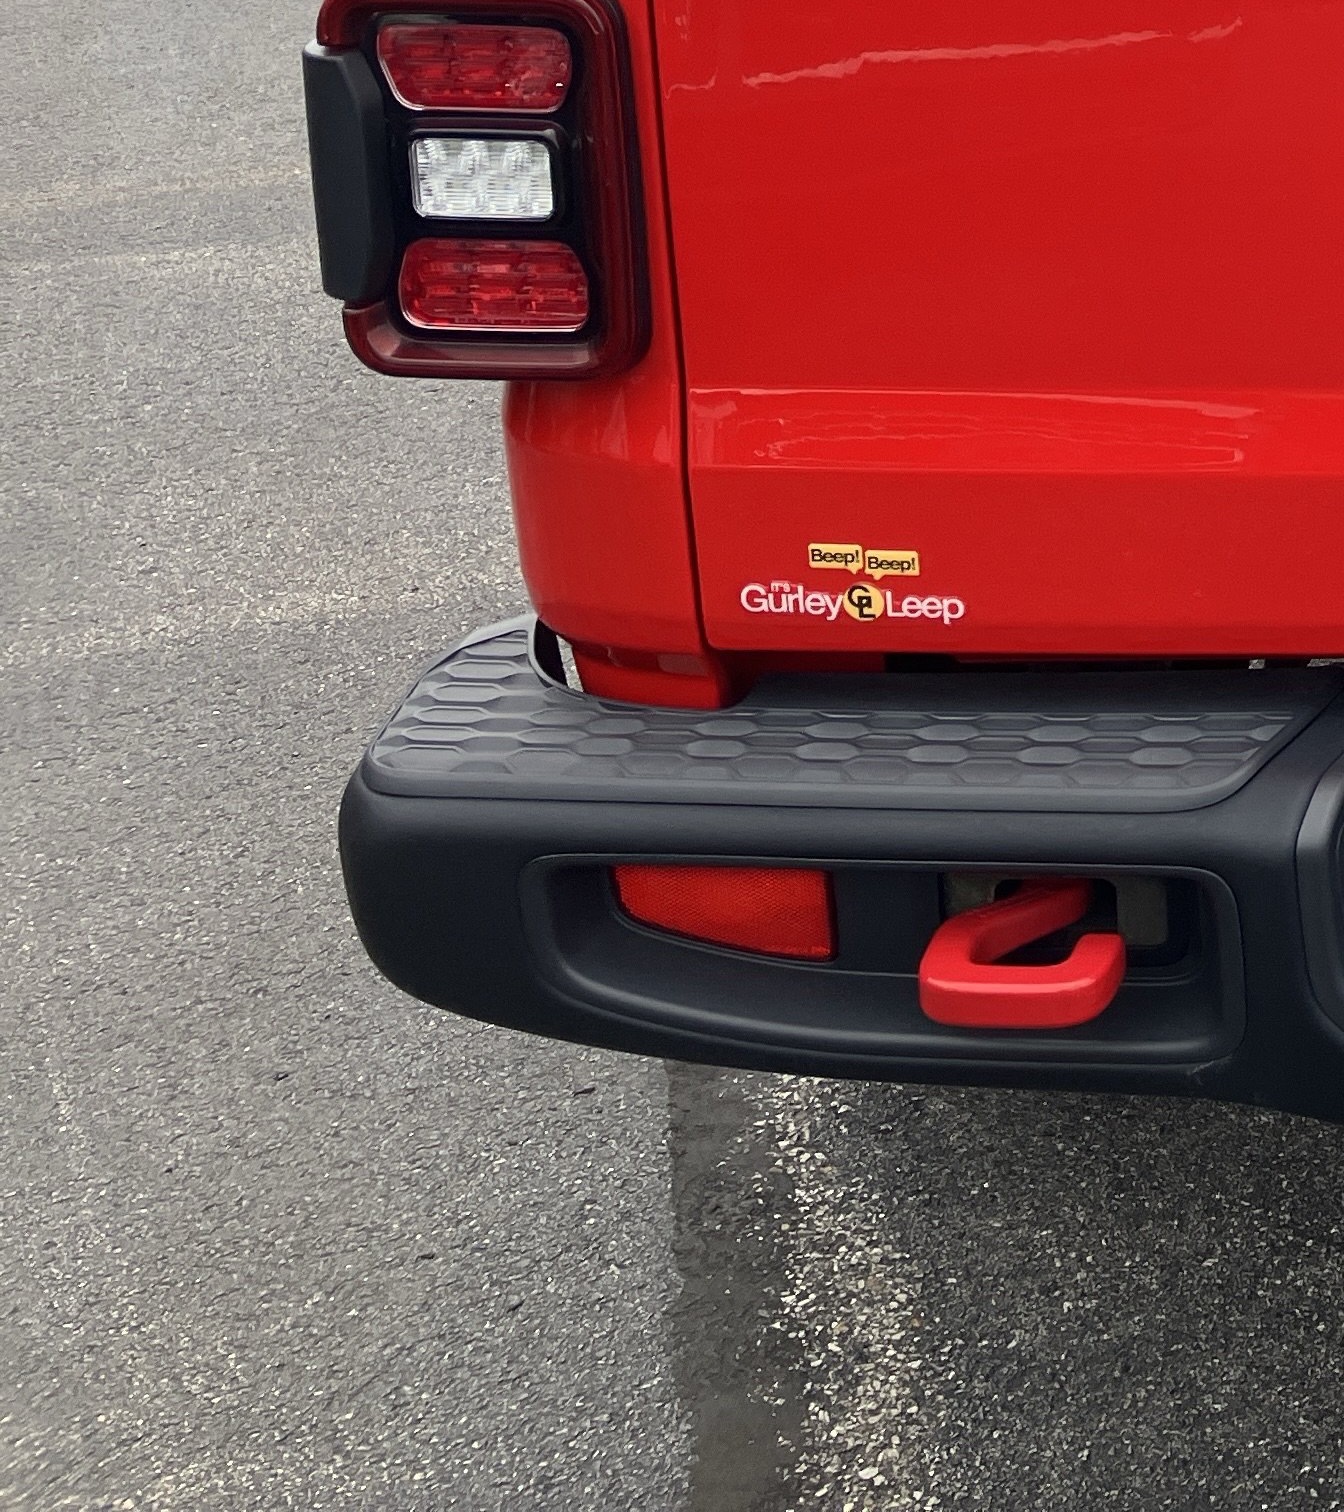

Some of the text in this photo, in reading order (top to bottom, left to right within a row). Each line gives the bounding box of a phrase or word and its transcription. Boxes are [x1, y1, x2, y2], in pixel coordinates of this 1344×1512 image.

[810, 548, 916, 571] Beep! Beep!
[740, 583, 843, 620] Gurley
[886, 591, 965, 624] Leep
